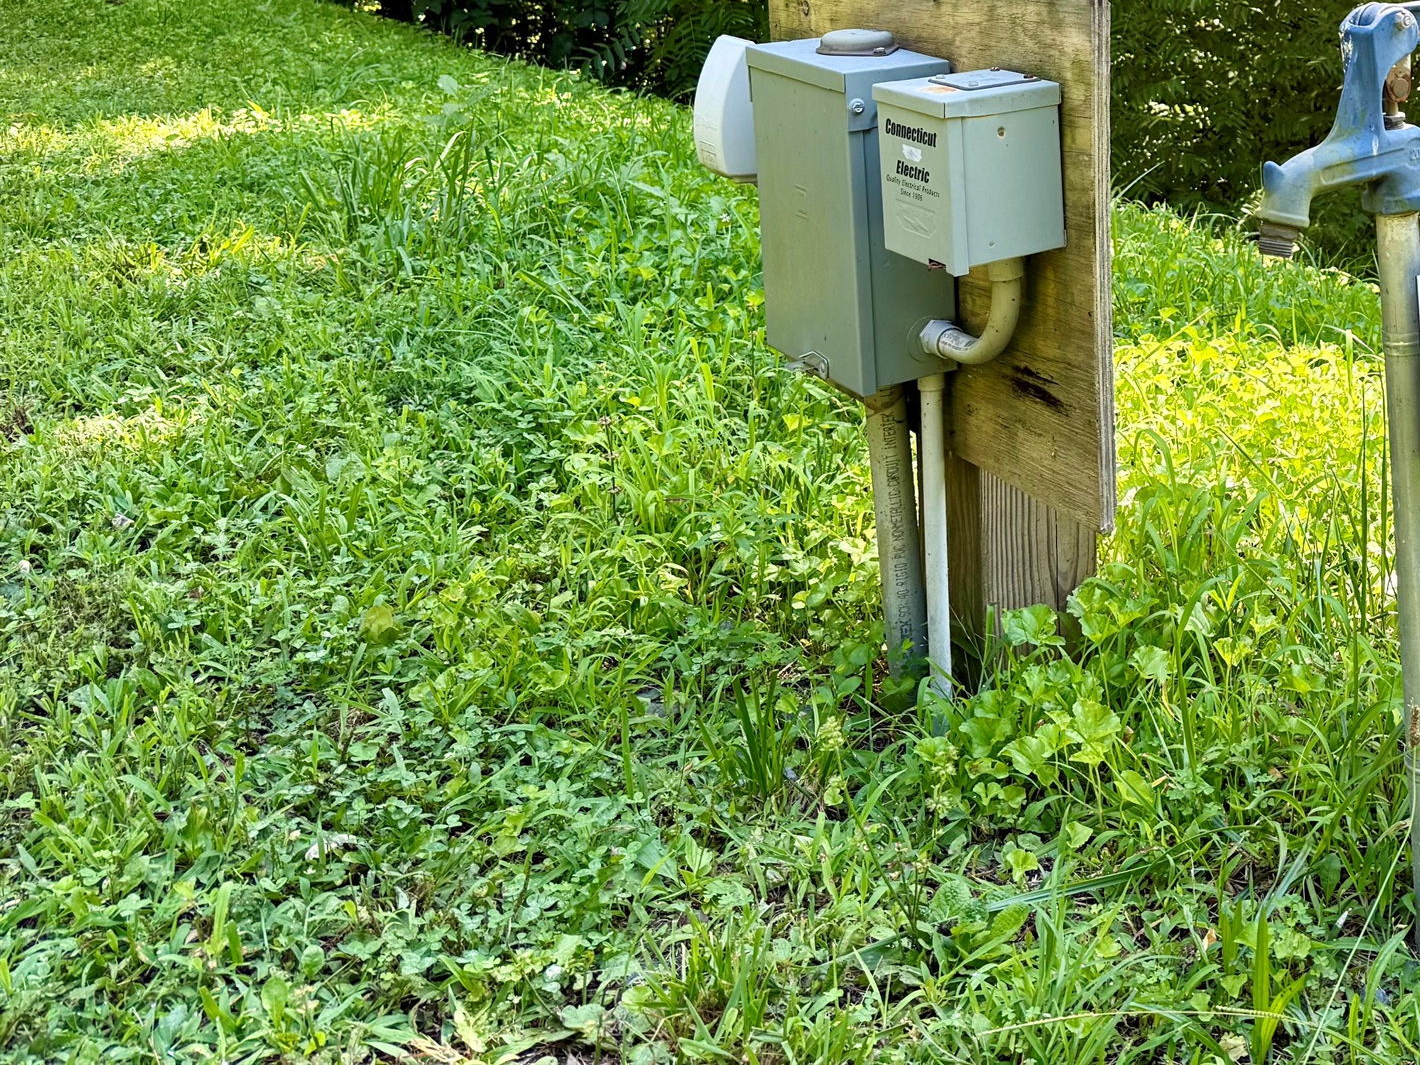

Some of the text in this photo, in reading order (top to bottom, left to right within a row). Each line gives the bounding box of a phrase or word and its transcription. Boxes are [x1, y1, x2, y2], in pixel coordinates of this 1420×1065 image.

[885, 118, 937, 148] Connecticut
[896, 159, 930, 183] Electric
[886, 174, 940, 198] Quality Electrical Products
[900, 188, 923, 202] Since 1906
[893, 544, 906, 559] PVC
[894, 563, 908, 586] RIGID
